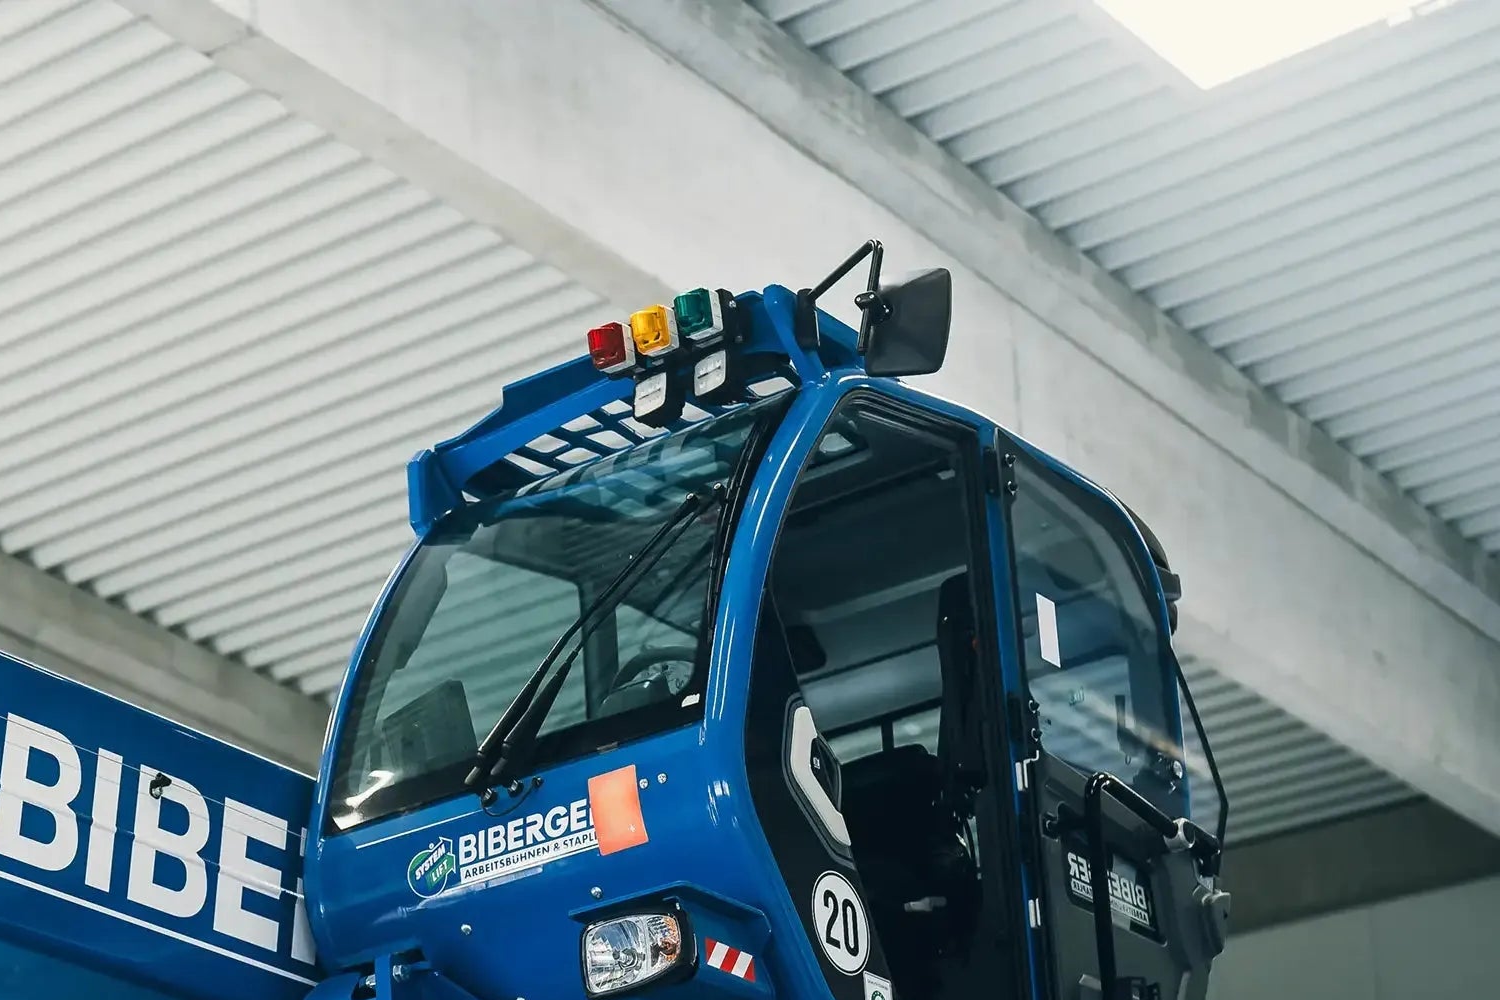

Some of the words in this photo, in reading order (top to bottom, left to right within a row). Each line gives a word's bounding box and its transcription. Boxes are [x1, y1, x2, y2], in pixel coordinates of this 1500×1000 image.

[459, 798, 596, 866] BIBERGE
[415, 842, 447, 881] SYSTEM
[431, 859, 449, 882] LIFT
[464, 846, 550, 880] ARBEITSBÜHNEN
[553, 842, 561, 852] &
[823, 889, 859, 957] 20
